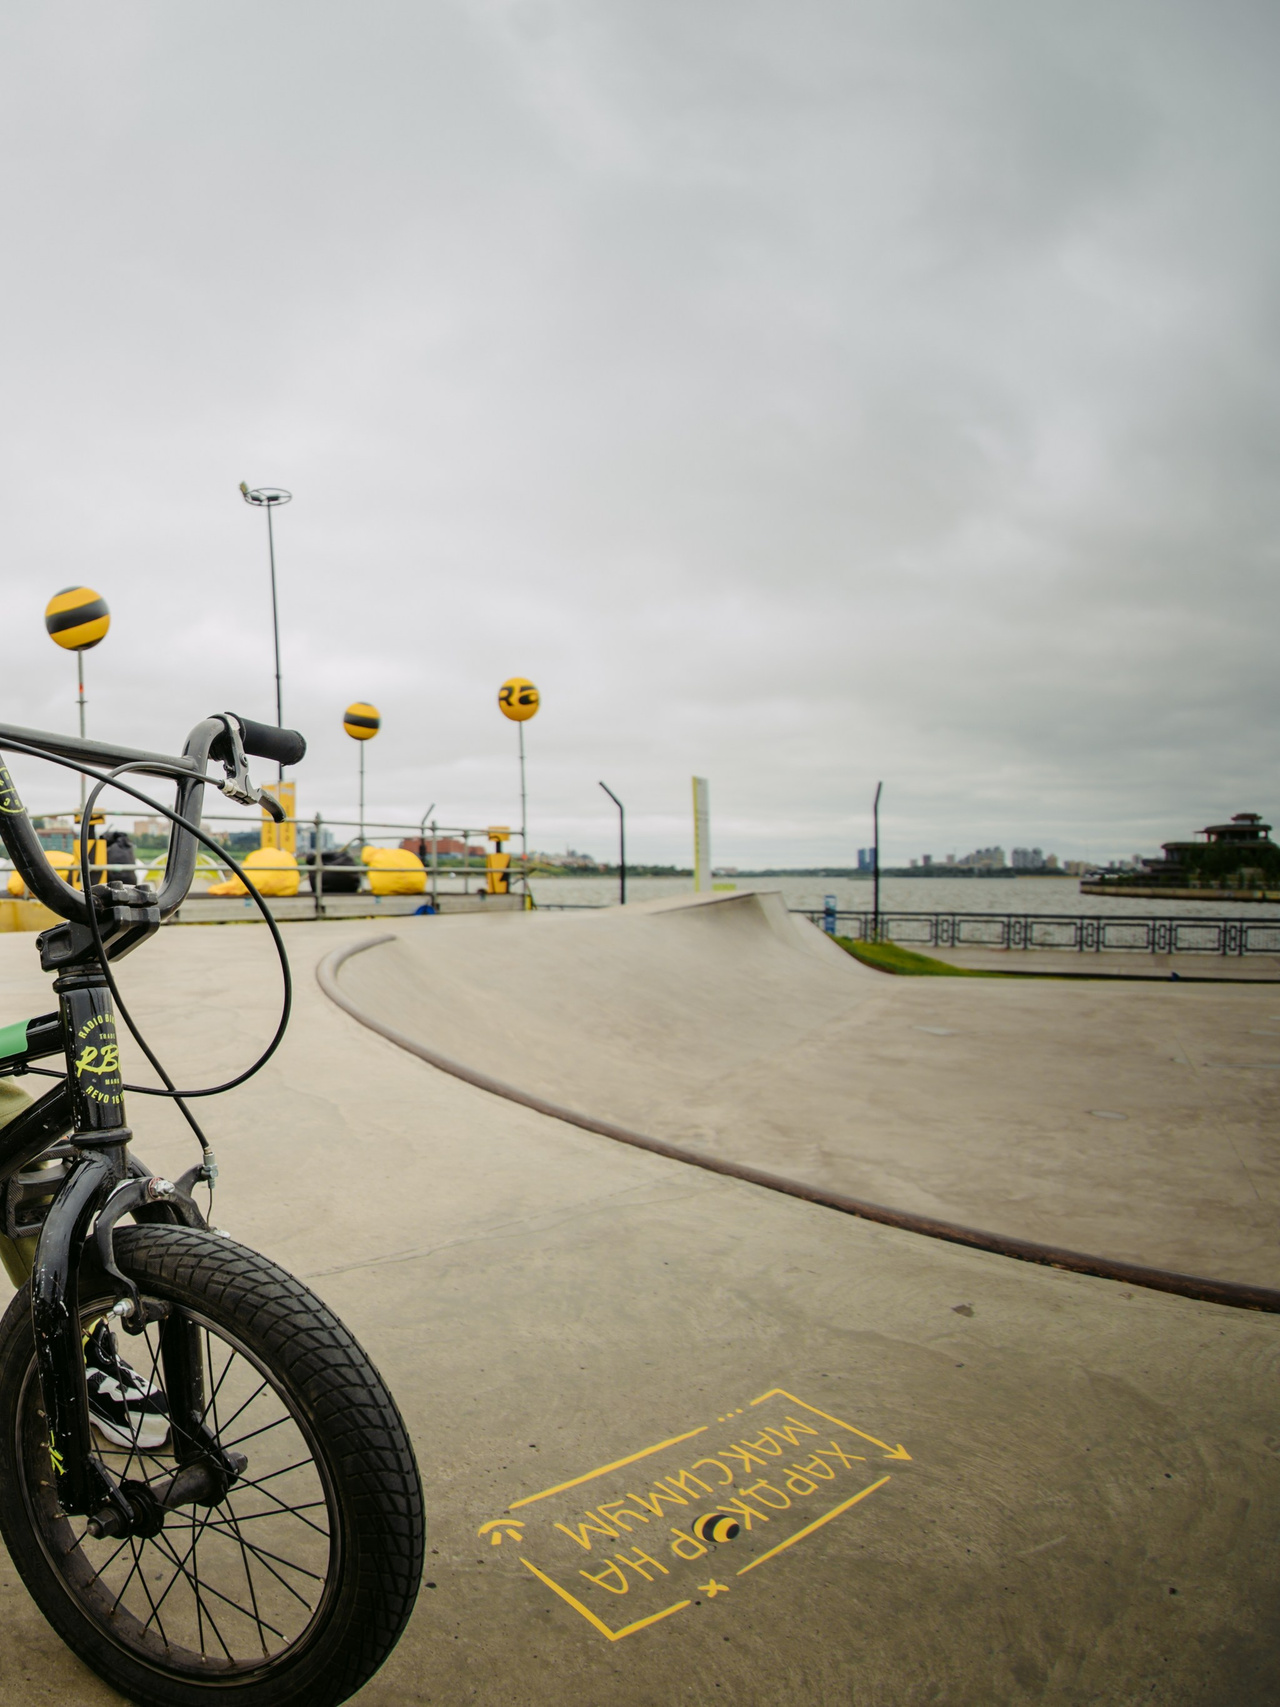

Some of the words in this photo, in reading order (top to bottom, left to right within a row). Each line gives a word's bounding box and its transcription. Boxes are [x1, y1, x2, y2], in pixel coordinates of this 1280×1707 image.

[78, 1014, 104, 1039] RADIO
[85, 1085, 110, 1104] REVO
[554, 1416, 819, 1550] МАКСИМУМ
[579, 1546, 670, 1594] НА
